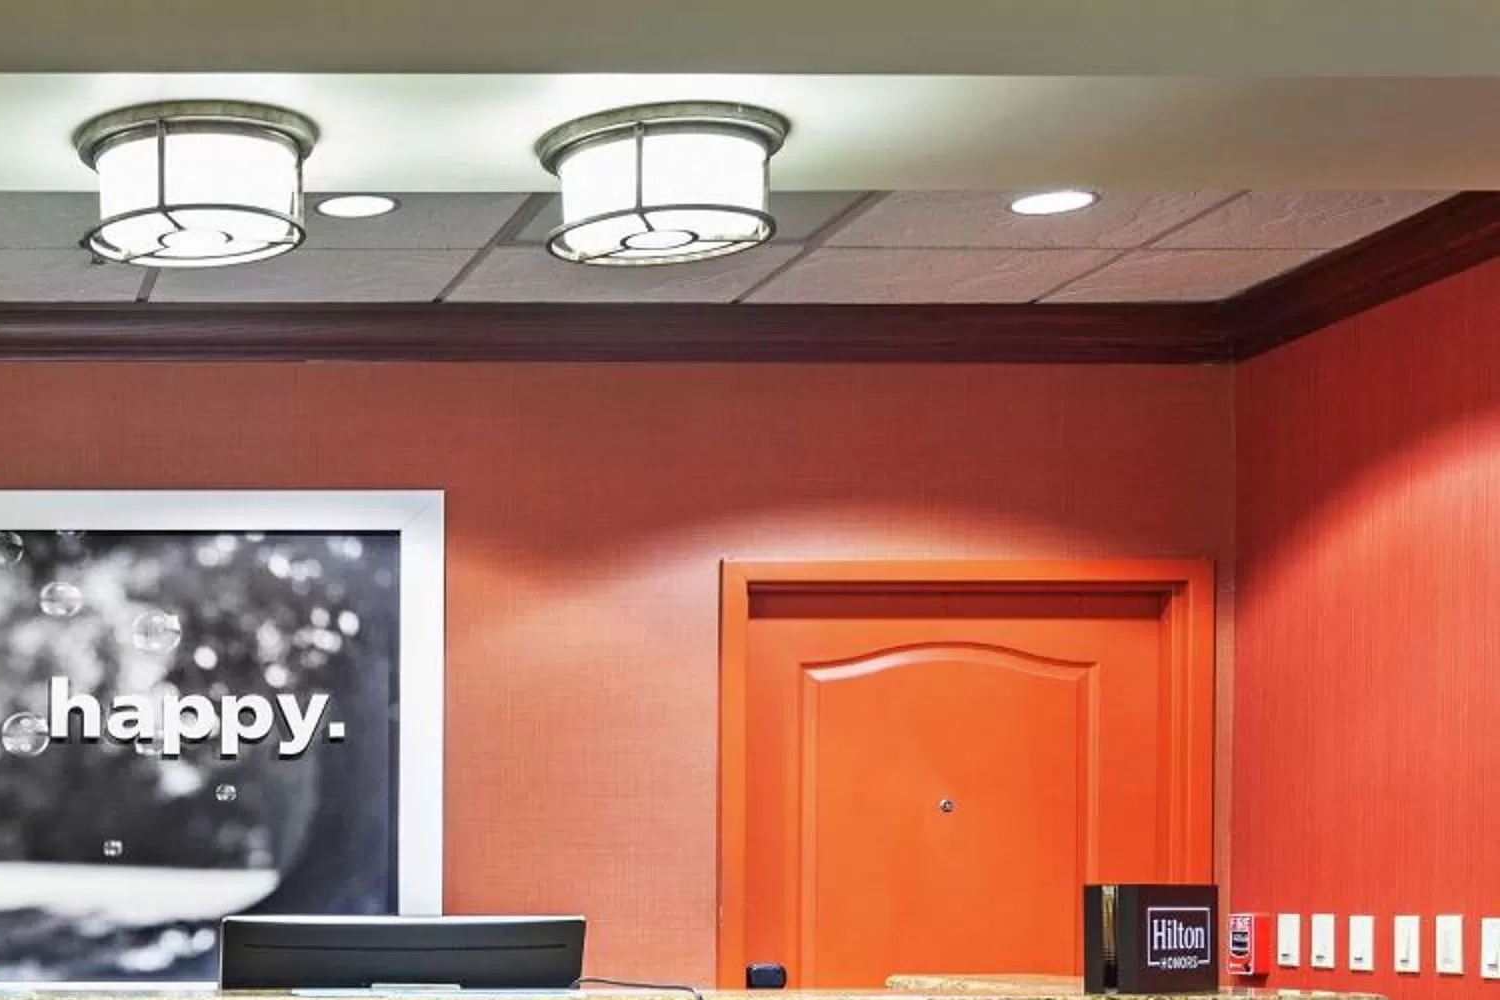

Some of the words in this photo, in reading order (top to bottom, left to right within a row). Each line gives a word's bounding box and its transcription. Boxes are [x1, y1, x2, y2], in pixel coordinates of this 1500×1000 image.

[51, 675, 346, 757] happy.
[1152, 919, 1205, 950] Hilton
[1230, 917, 1251, 930] FIRE
[1160, 956, 1199, 969] HONORS
